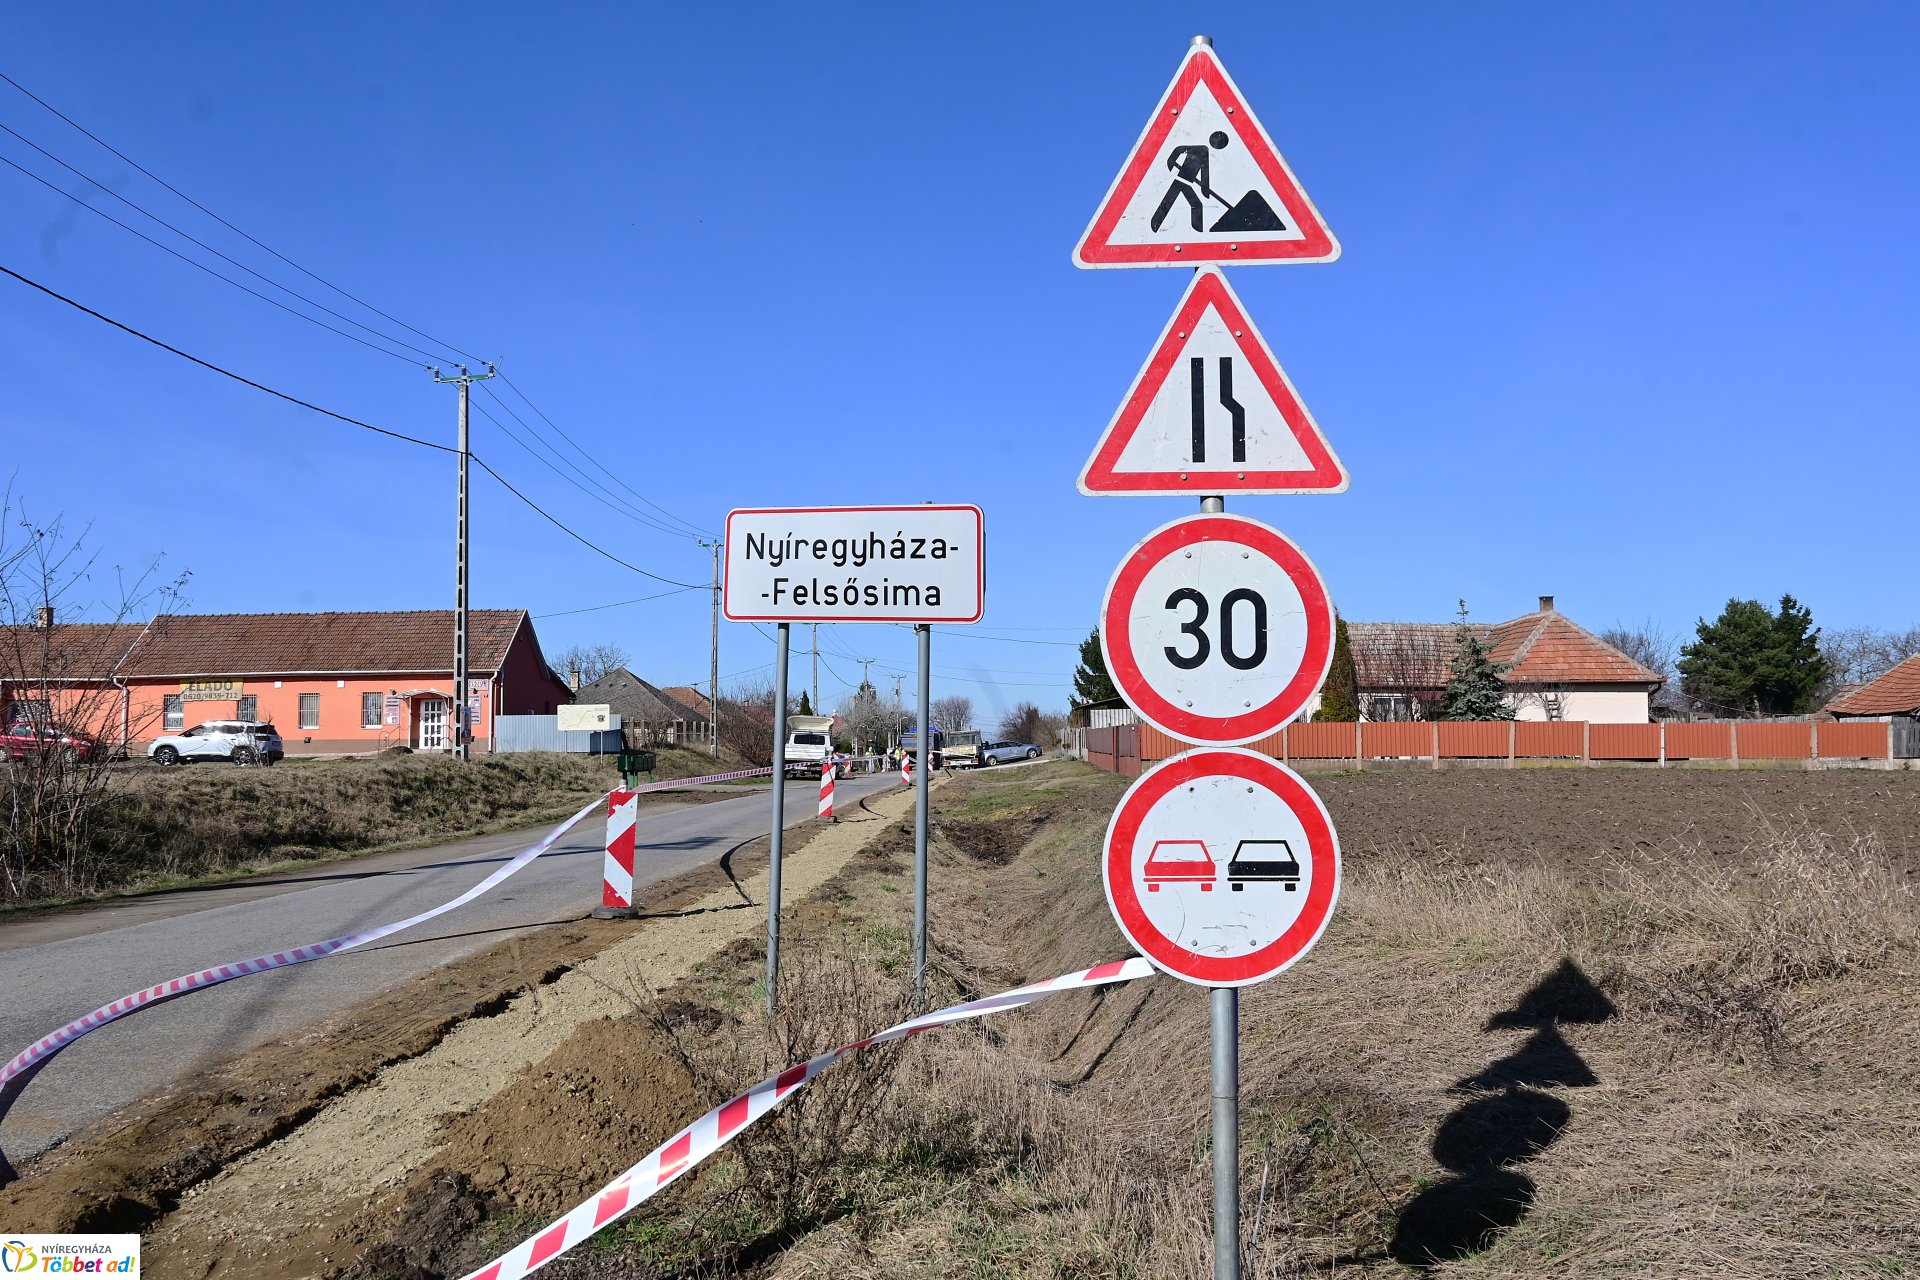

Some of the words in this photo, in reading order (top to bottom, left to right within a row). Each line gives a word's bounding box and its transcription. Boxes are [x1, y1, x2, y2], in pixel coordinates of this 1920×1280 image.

[745, 530, 959, 568] Nyíregyháza-
[761, 577, 941, 606] -Felsősima
[1163, 587, 1268, 671] 30
